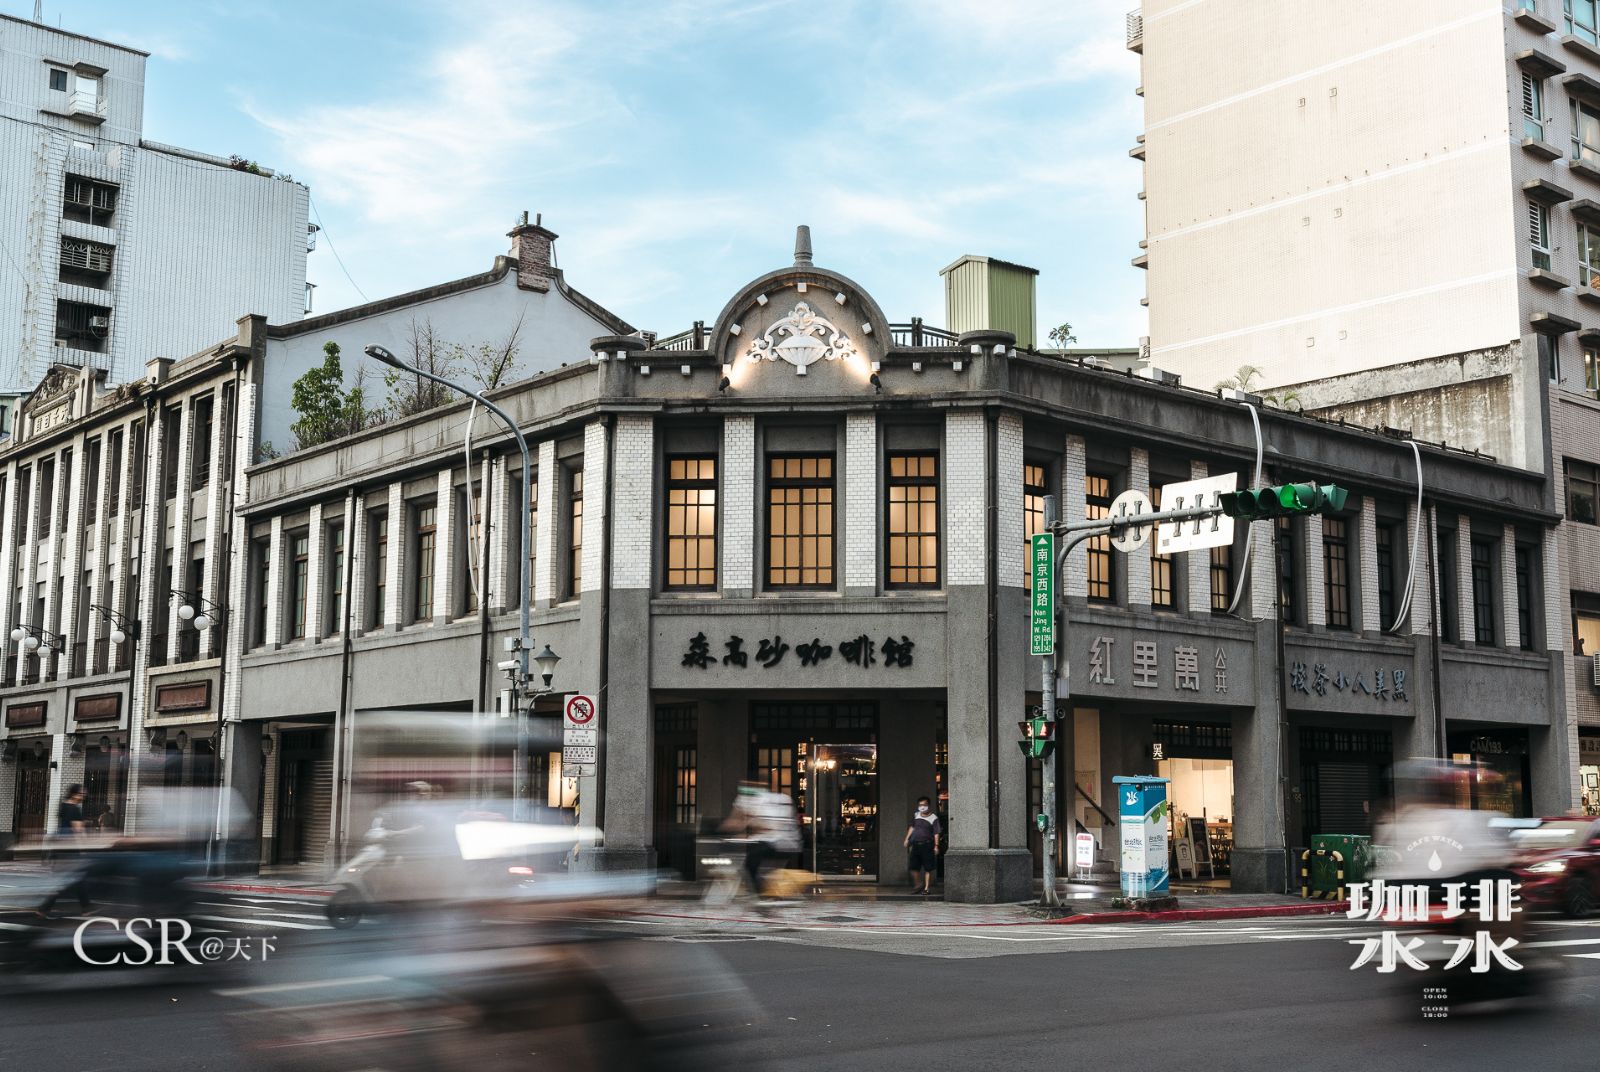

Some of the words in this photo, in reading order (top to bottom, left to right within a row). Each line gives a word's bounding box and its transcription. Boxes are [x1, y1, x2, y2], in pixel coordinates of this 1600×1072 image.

[1037, 548, 1048, 607] 南京西路
[681, 631, 916, 670] 森高砂咖啡館
